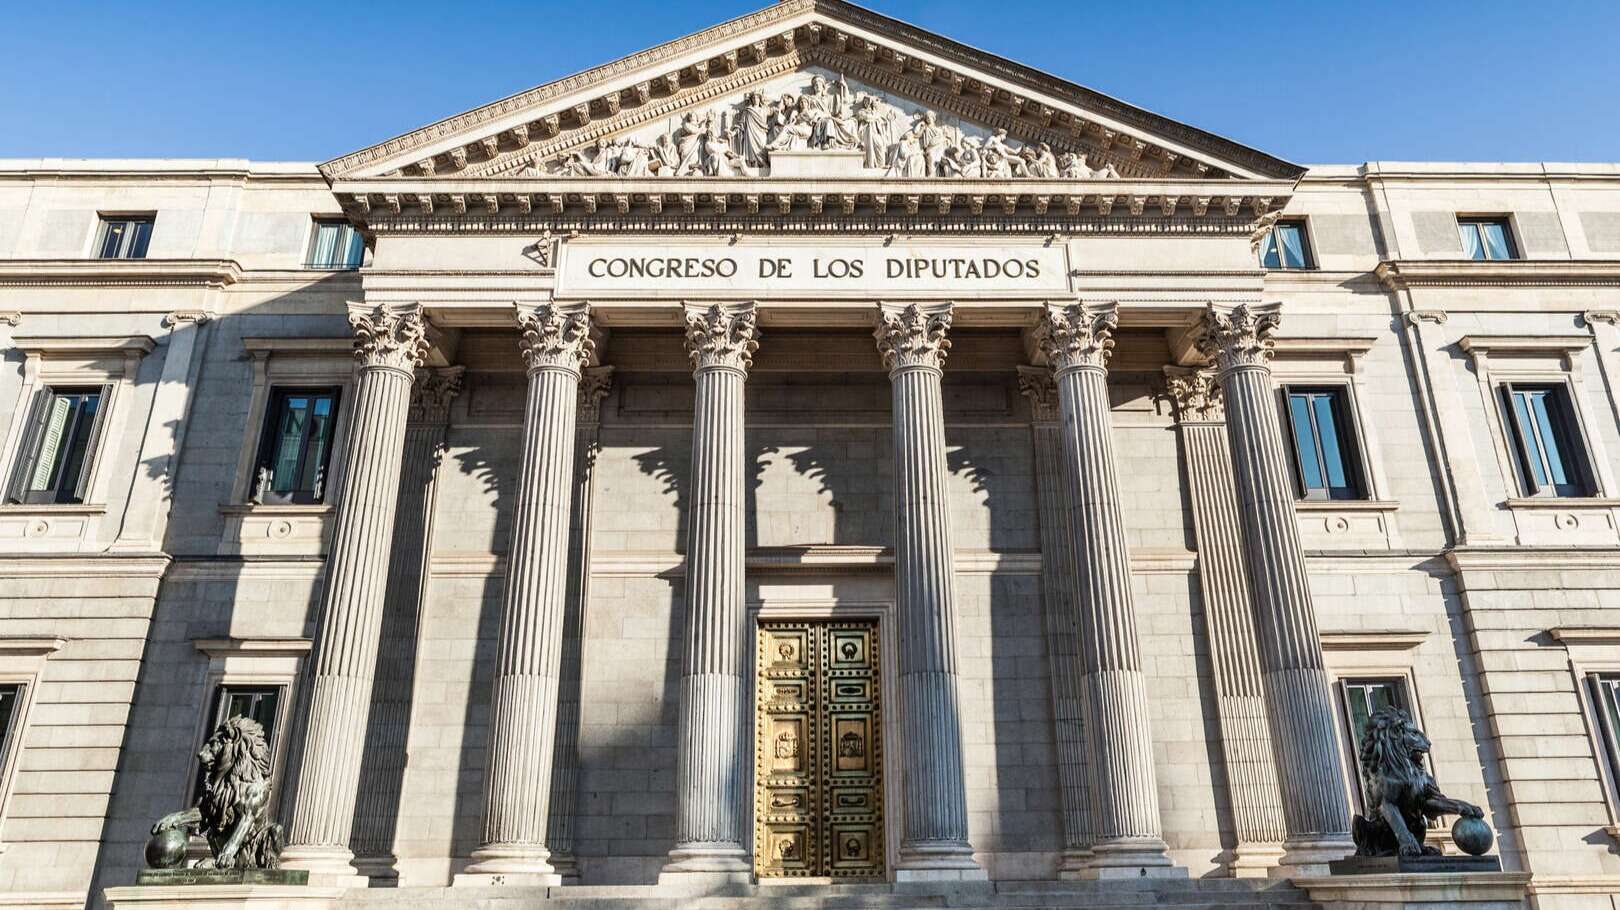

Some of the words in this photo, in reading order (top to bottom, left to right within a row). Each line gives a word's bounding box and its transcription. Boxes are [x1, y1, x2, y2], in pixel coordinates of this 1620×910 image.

[588, 258, 738, 278] CONGRESO
[759, 258, 792, 278] DE
[813, 258, 864, 278] LOS
[886, 258, 1040, 279] DIPUTADOS
